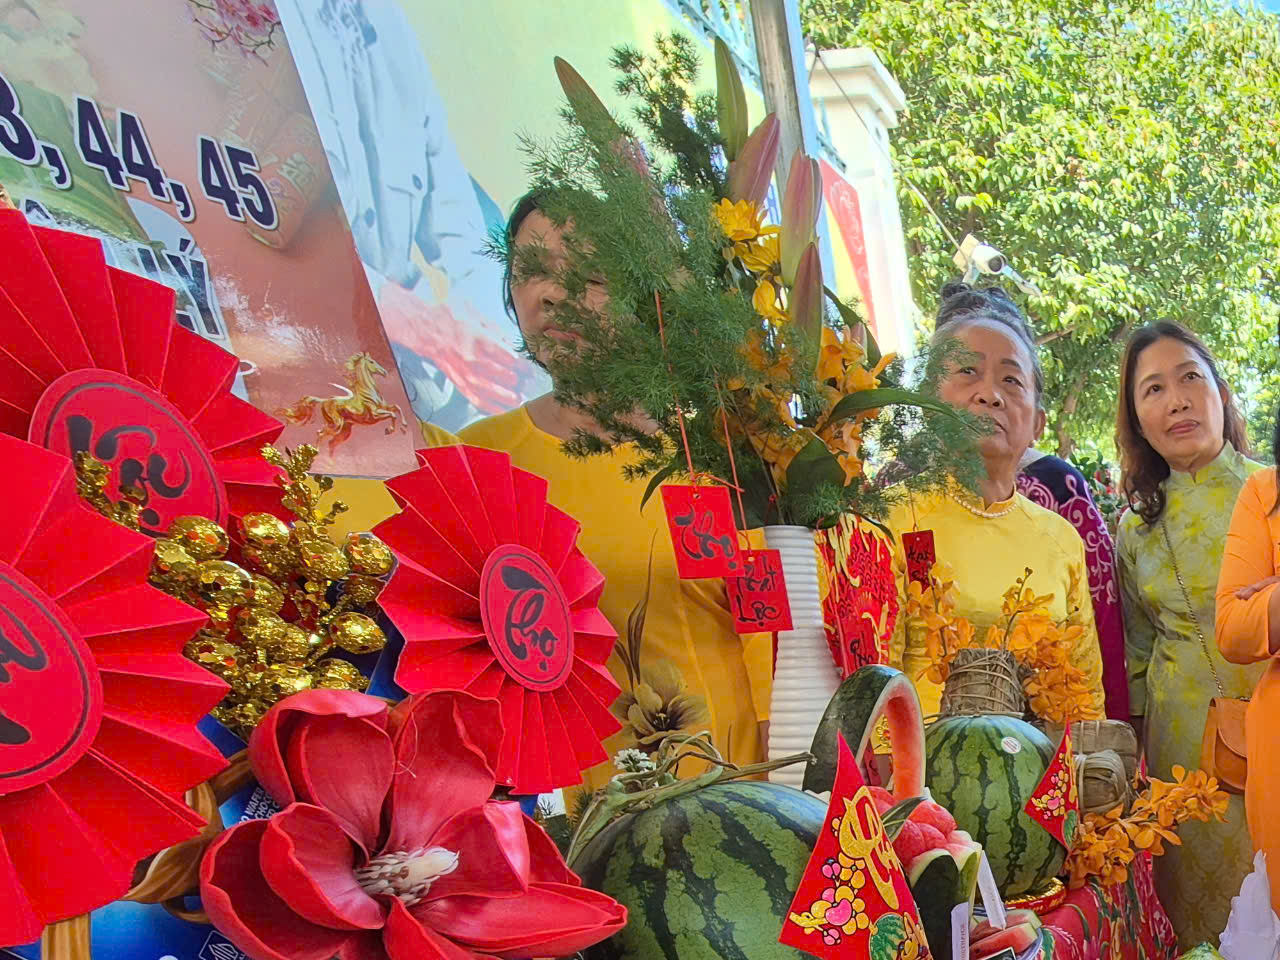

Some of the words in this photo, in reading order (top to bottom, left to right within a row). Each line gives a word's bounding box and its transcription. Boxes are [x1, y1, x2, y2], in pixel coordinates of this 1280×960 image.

[0, 74, 71, 187] 3,
[76, 96, 193, 219] 44,
[199, 136, 278, 228] 45
